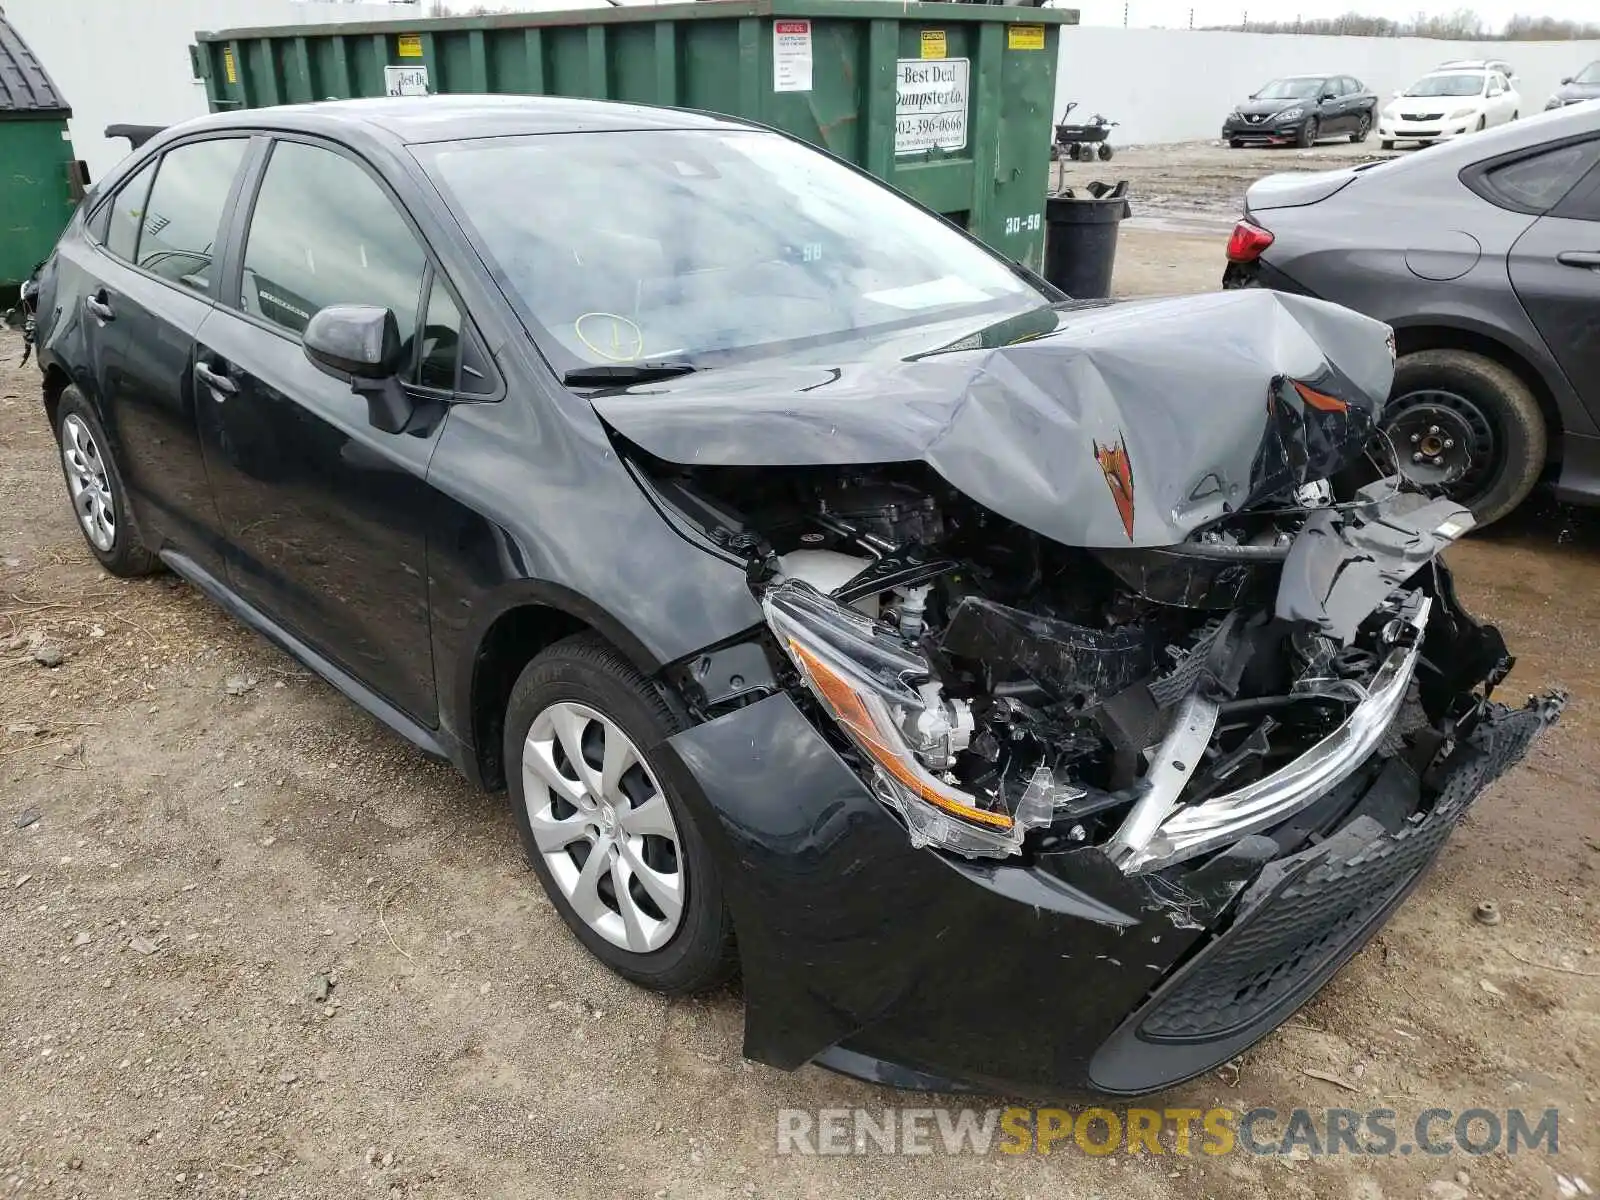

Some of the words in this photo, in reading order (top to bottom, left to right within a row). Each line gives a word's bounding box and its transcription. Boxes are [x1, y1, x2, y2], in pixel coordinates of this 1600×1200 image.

[905, 66, 929, 83] Best
[933, 65, 956, 82] Deal
[896, 117, 962, 135] 02-396-0666
